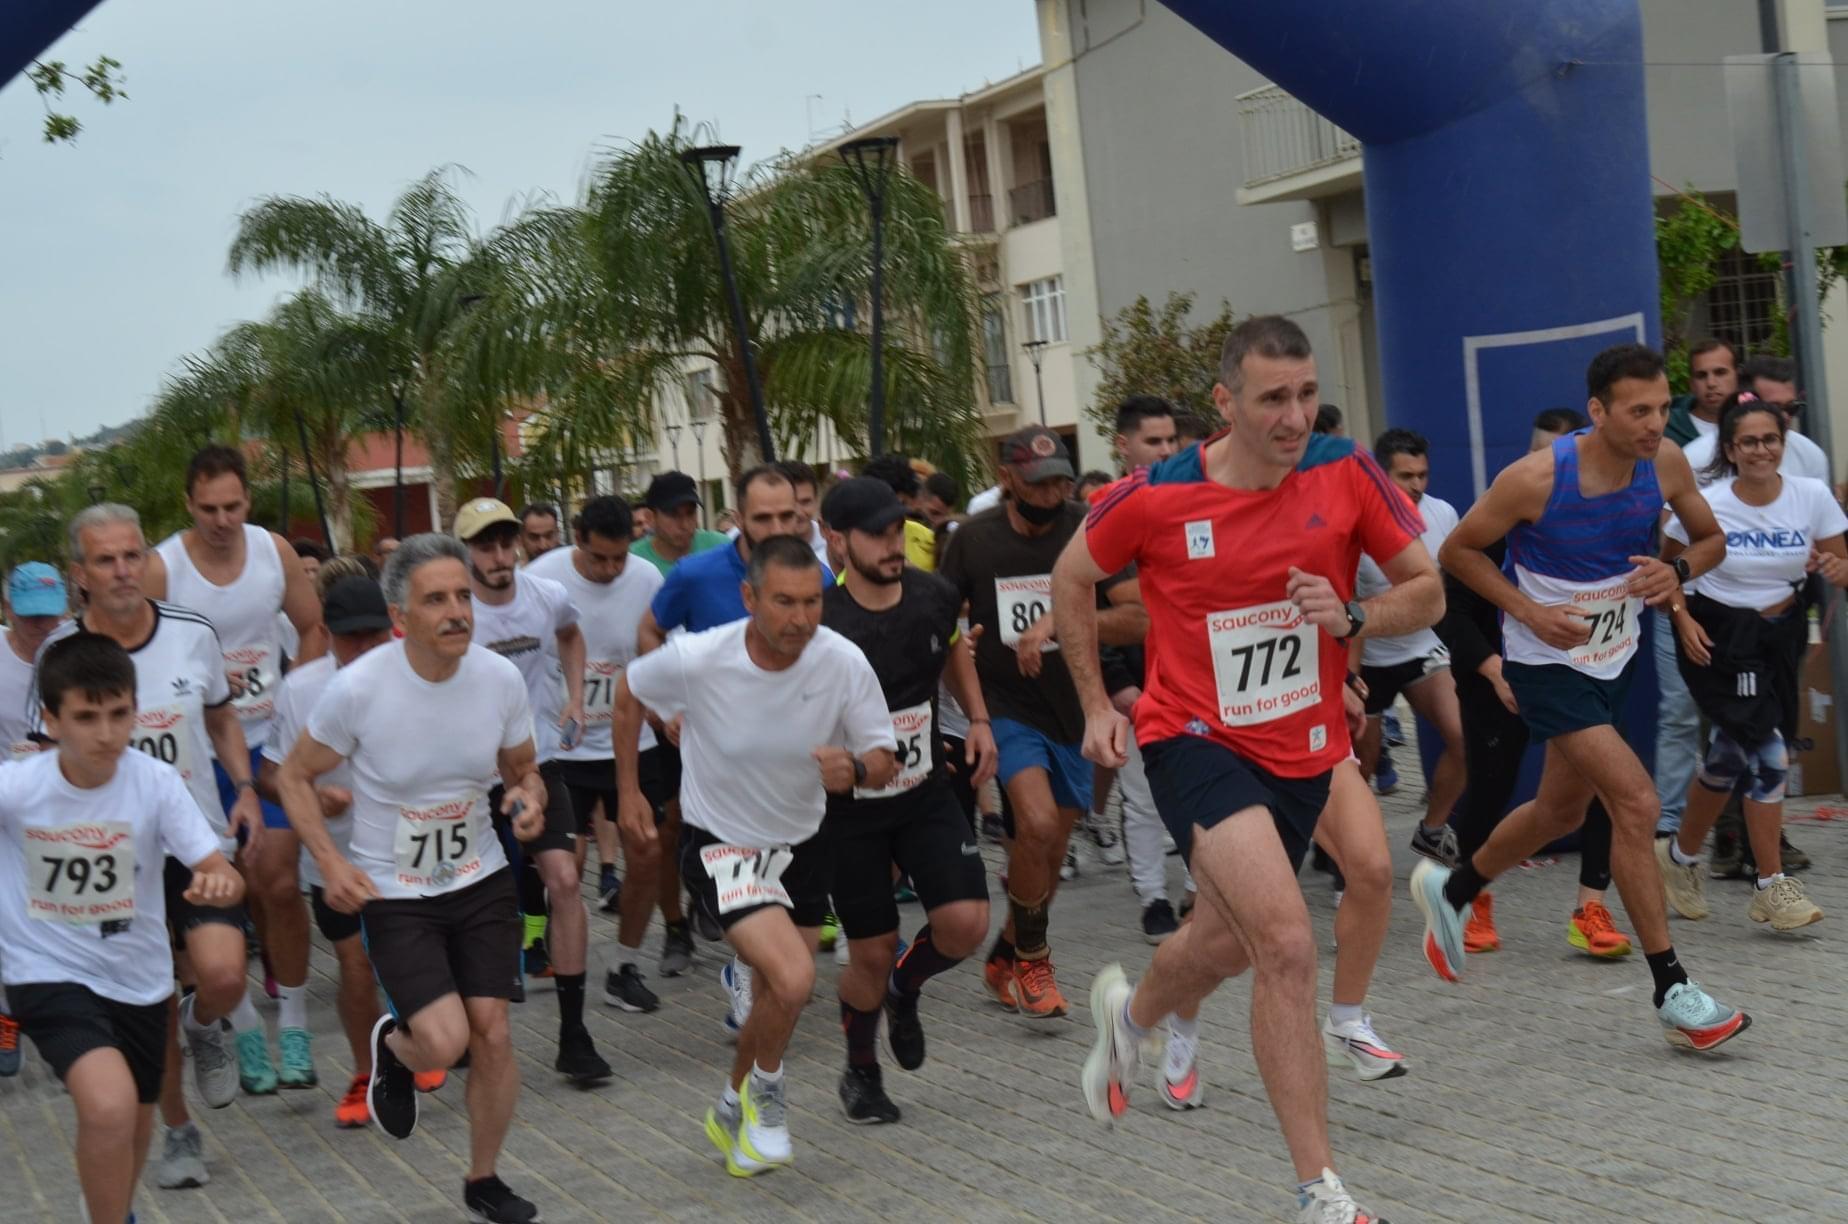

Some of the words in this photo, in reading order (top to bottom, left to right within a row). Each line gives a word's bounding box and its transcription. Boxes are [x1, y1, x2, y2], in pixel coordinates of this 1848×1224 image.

[1012, 601, 1046, 633] 80
[1212, 606, 1292, 632] saucony
[1584, 601, 1626, 645] 724
[1231, 634, 1301, 692] 772
[1223, 704, 1252, 717] run
[1256, 698, 1278, 712] for
[1281, 682, 1318, 707] good
[130, 733, 177, 765] 00
[411, 822, 467, 868] 715
[42, 854, 117, 895] 793
[399, 874, 424, 885] run
